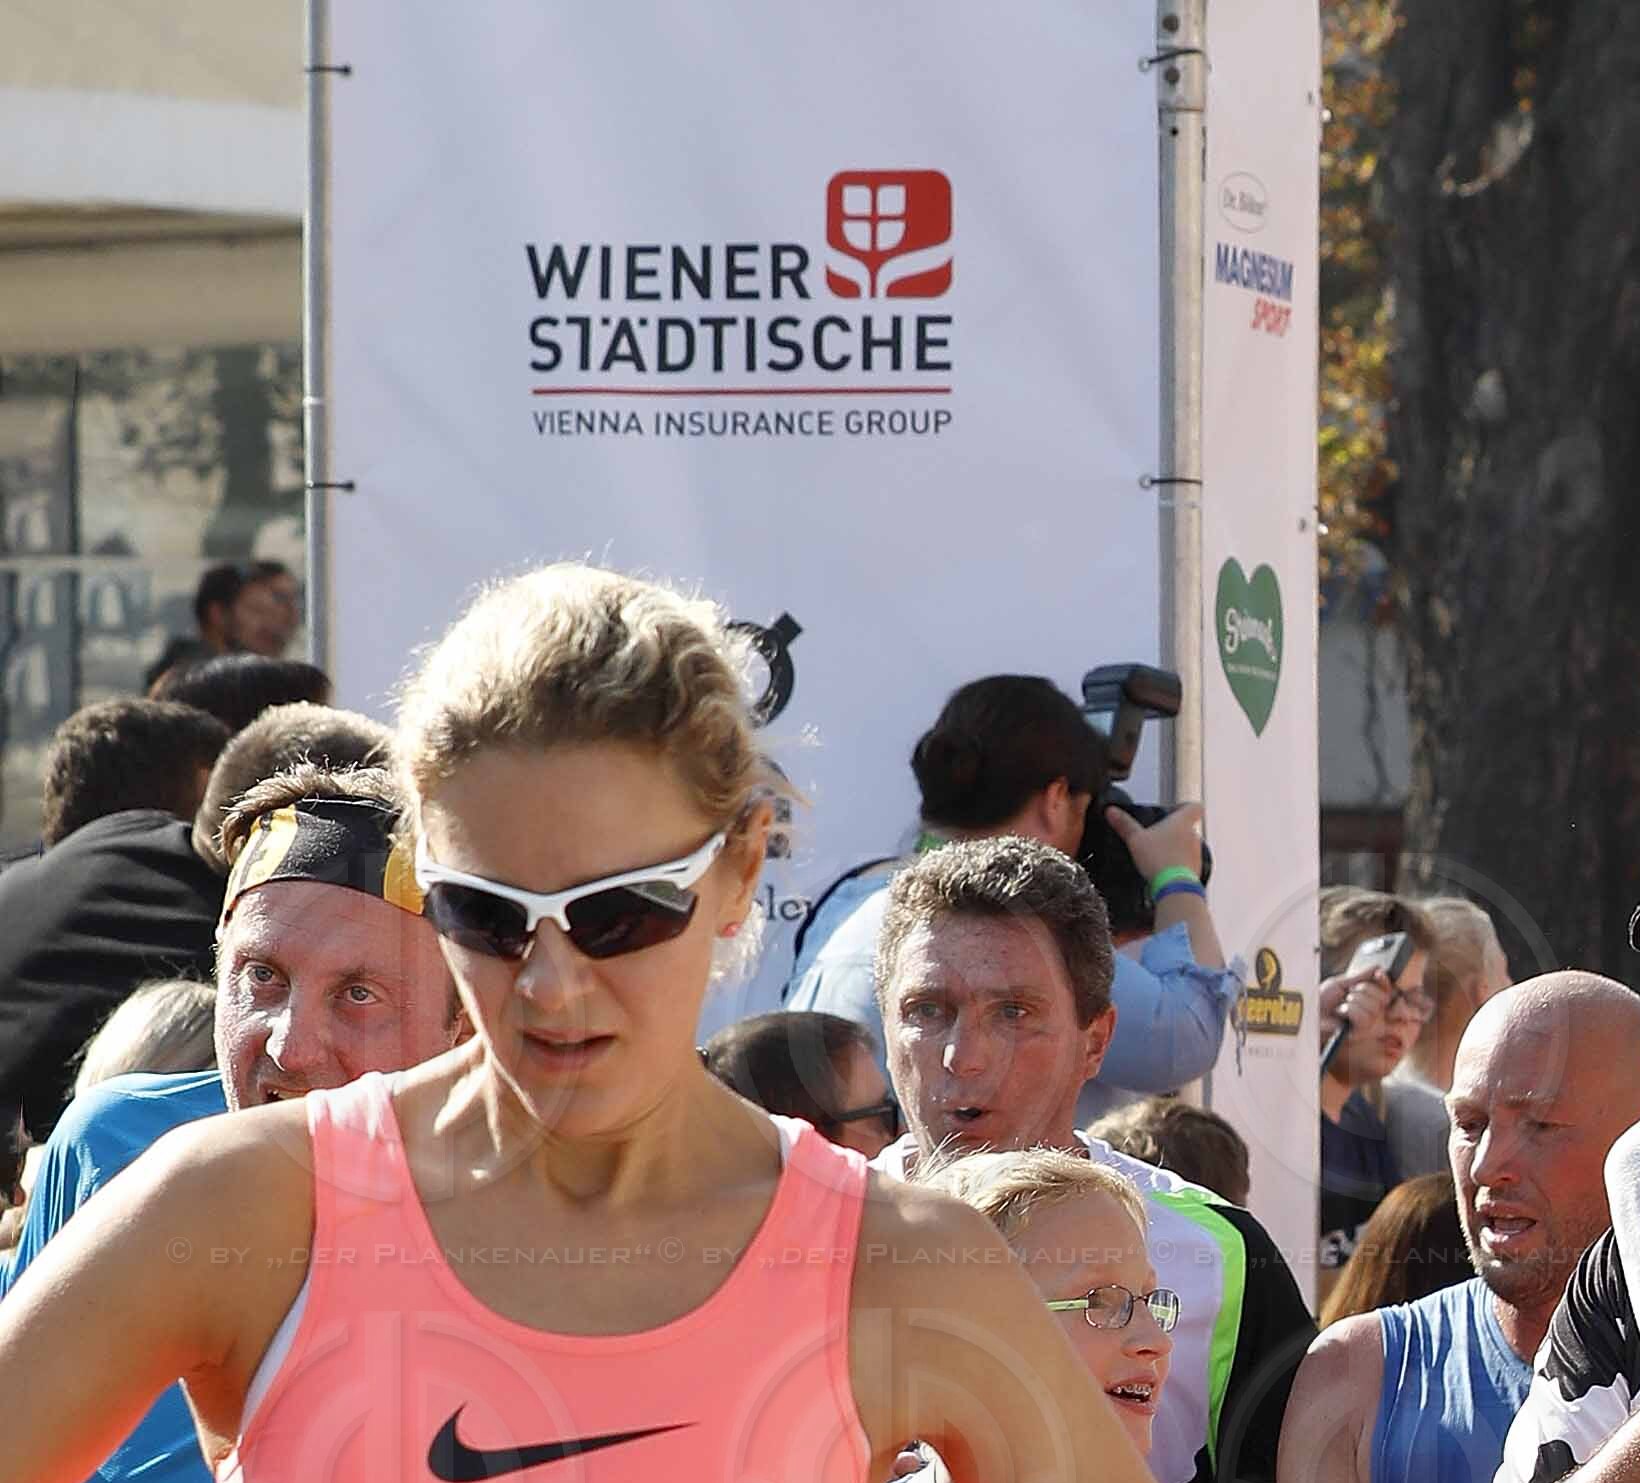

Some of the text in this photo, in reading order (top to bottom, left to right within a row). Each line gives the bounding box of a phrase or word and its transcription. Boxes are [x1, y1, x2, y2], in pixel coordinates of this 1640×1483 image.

[525, 244, 811, 300] WIENER
[529, 314, 953, 373] STÄDTISCHE
[533, 409, 952, 435] VIENNA INSURANCE GROUP
